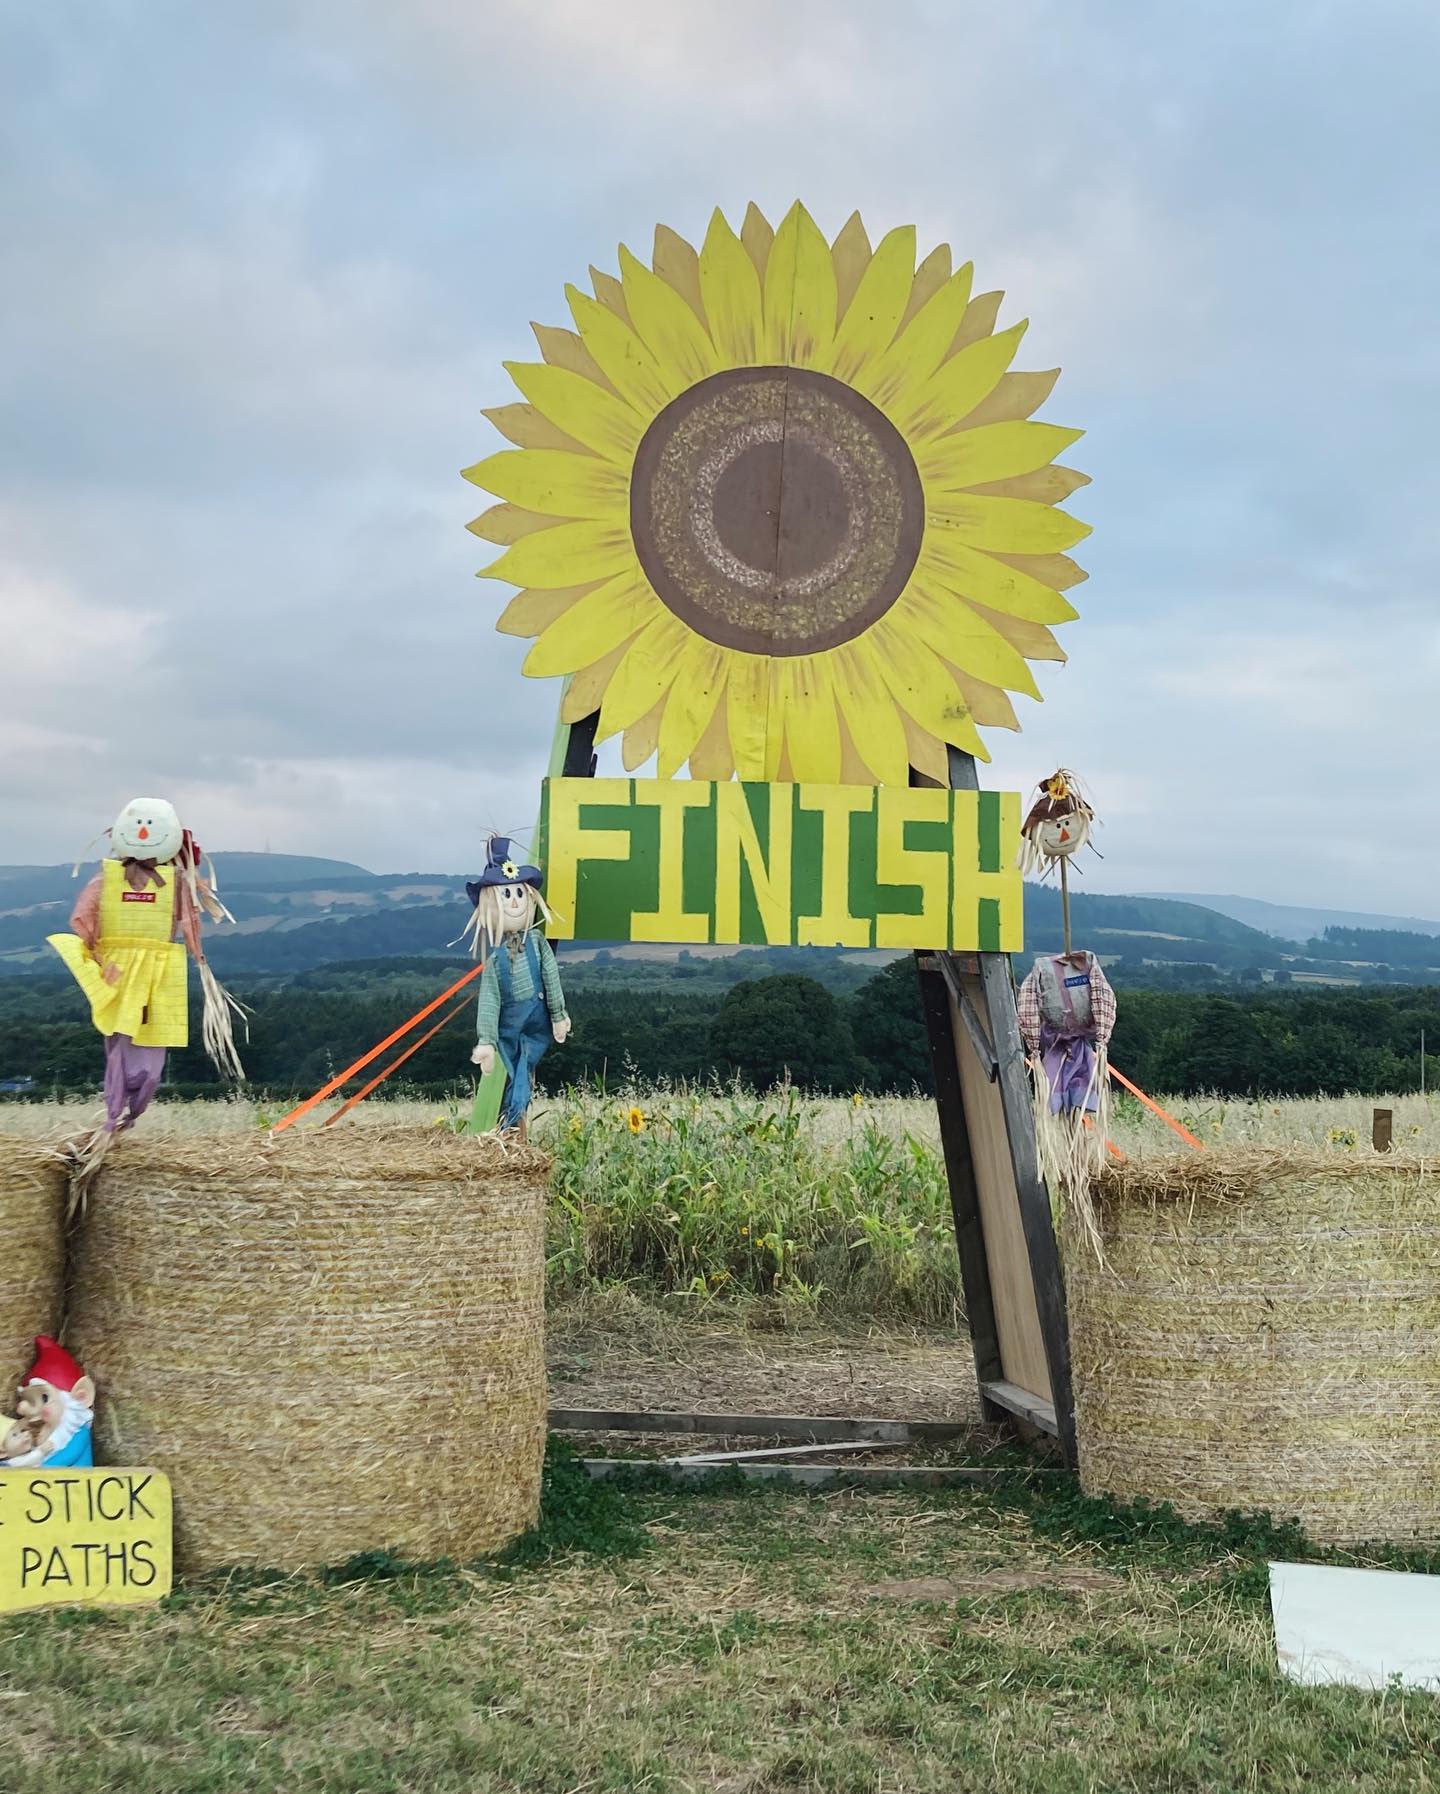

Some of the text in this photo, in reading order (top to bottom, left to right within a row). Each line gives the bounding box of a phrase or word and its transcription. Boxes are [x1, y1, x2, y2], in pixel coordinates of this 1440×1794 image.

[545, 777, 1024, 952] FINISH
[26, 1475, 155, 1523] STICK
[21, 1540, 156, 1588] PATHS
